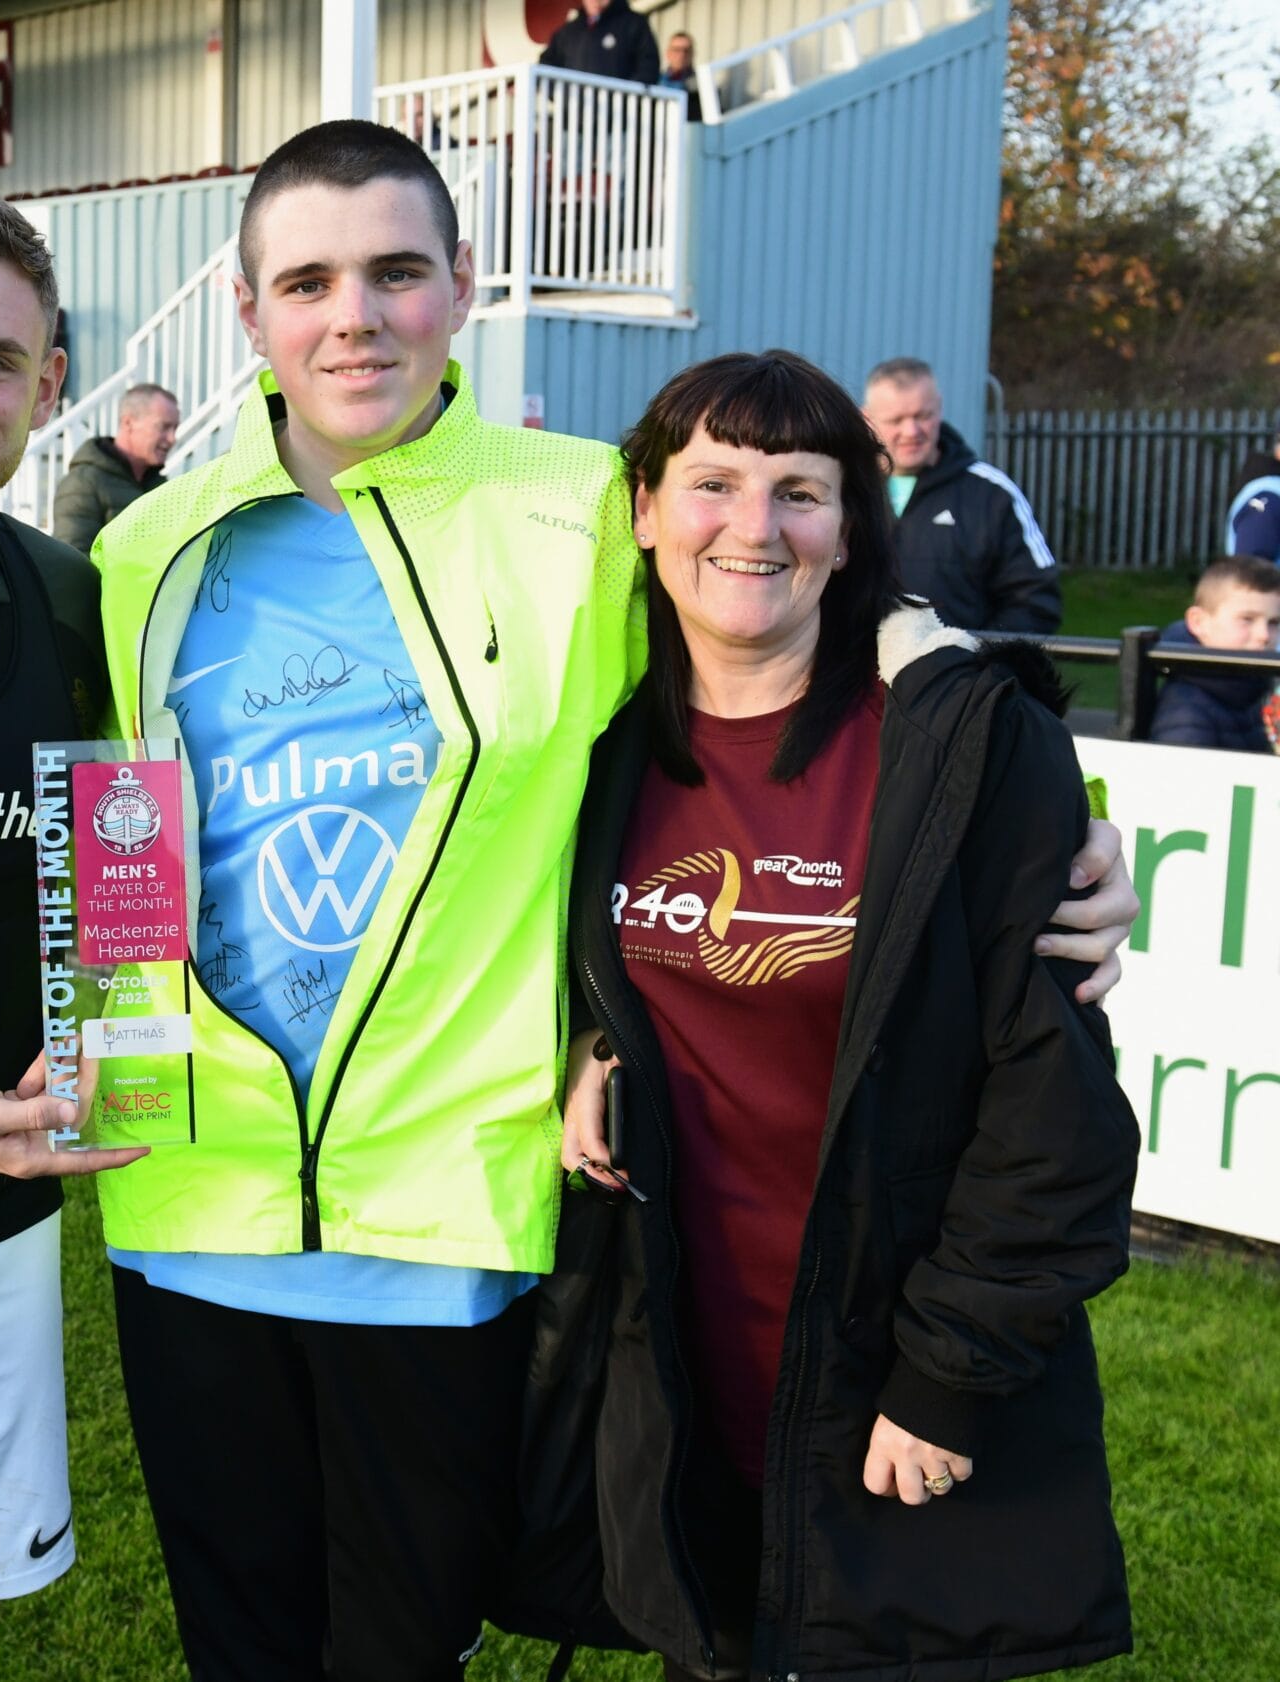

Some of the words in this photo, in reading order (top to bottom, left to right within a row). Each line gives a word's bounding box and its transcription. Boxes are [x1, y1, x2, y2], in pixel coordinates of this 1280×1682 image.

[527, 511, 597, 544] ALTURA
[208, 741, 445, 812] Pulma
[97, 793, 115, 816] SOUTH
[116, 788, 148, 803] SHIELDS
[37, 749, 70, 877] MONTH
[102, 864, 157, 880] MEN'S
[753, 859, 788, 875] great
[801, 861, 842, 876] north
[815, 877, 842, 888] run
[1129, 784, 1280, 969] rl
[94, 882, 143, 896] PLAYER
[147, 881, 166, 894] OF
[87, 900, 115, 912] THE
[120, 897, 173, 911] MONTH
[40, 887, 73, 955] THE
[84, 922, 179, 940] Mackenzie
[98, 943, 166, 960] Heaney
[625, 944, 662, 956] ordinary
[665, 950, 694, 960] people
[664, 958, 691, 968] things
[46, 963, 76, 1007] OF
[98, 976, 168, 990] OCTOBER
[116, 992, 153, 1005] 2022
[103, 1028, 166, 1042] MATTHIAS
[50, 1017, 80, 1142] PAYER
[115, 1077, 146, 1085] Produced
[148, 1077, 157, 1085] by
[103, 1089, 171, 1112] Aztec
[103, 1112, 143, 1123] COLOUR
[147, 1111, 171, 1120] PRINT
